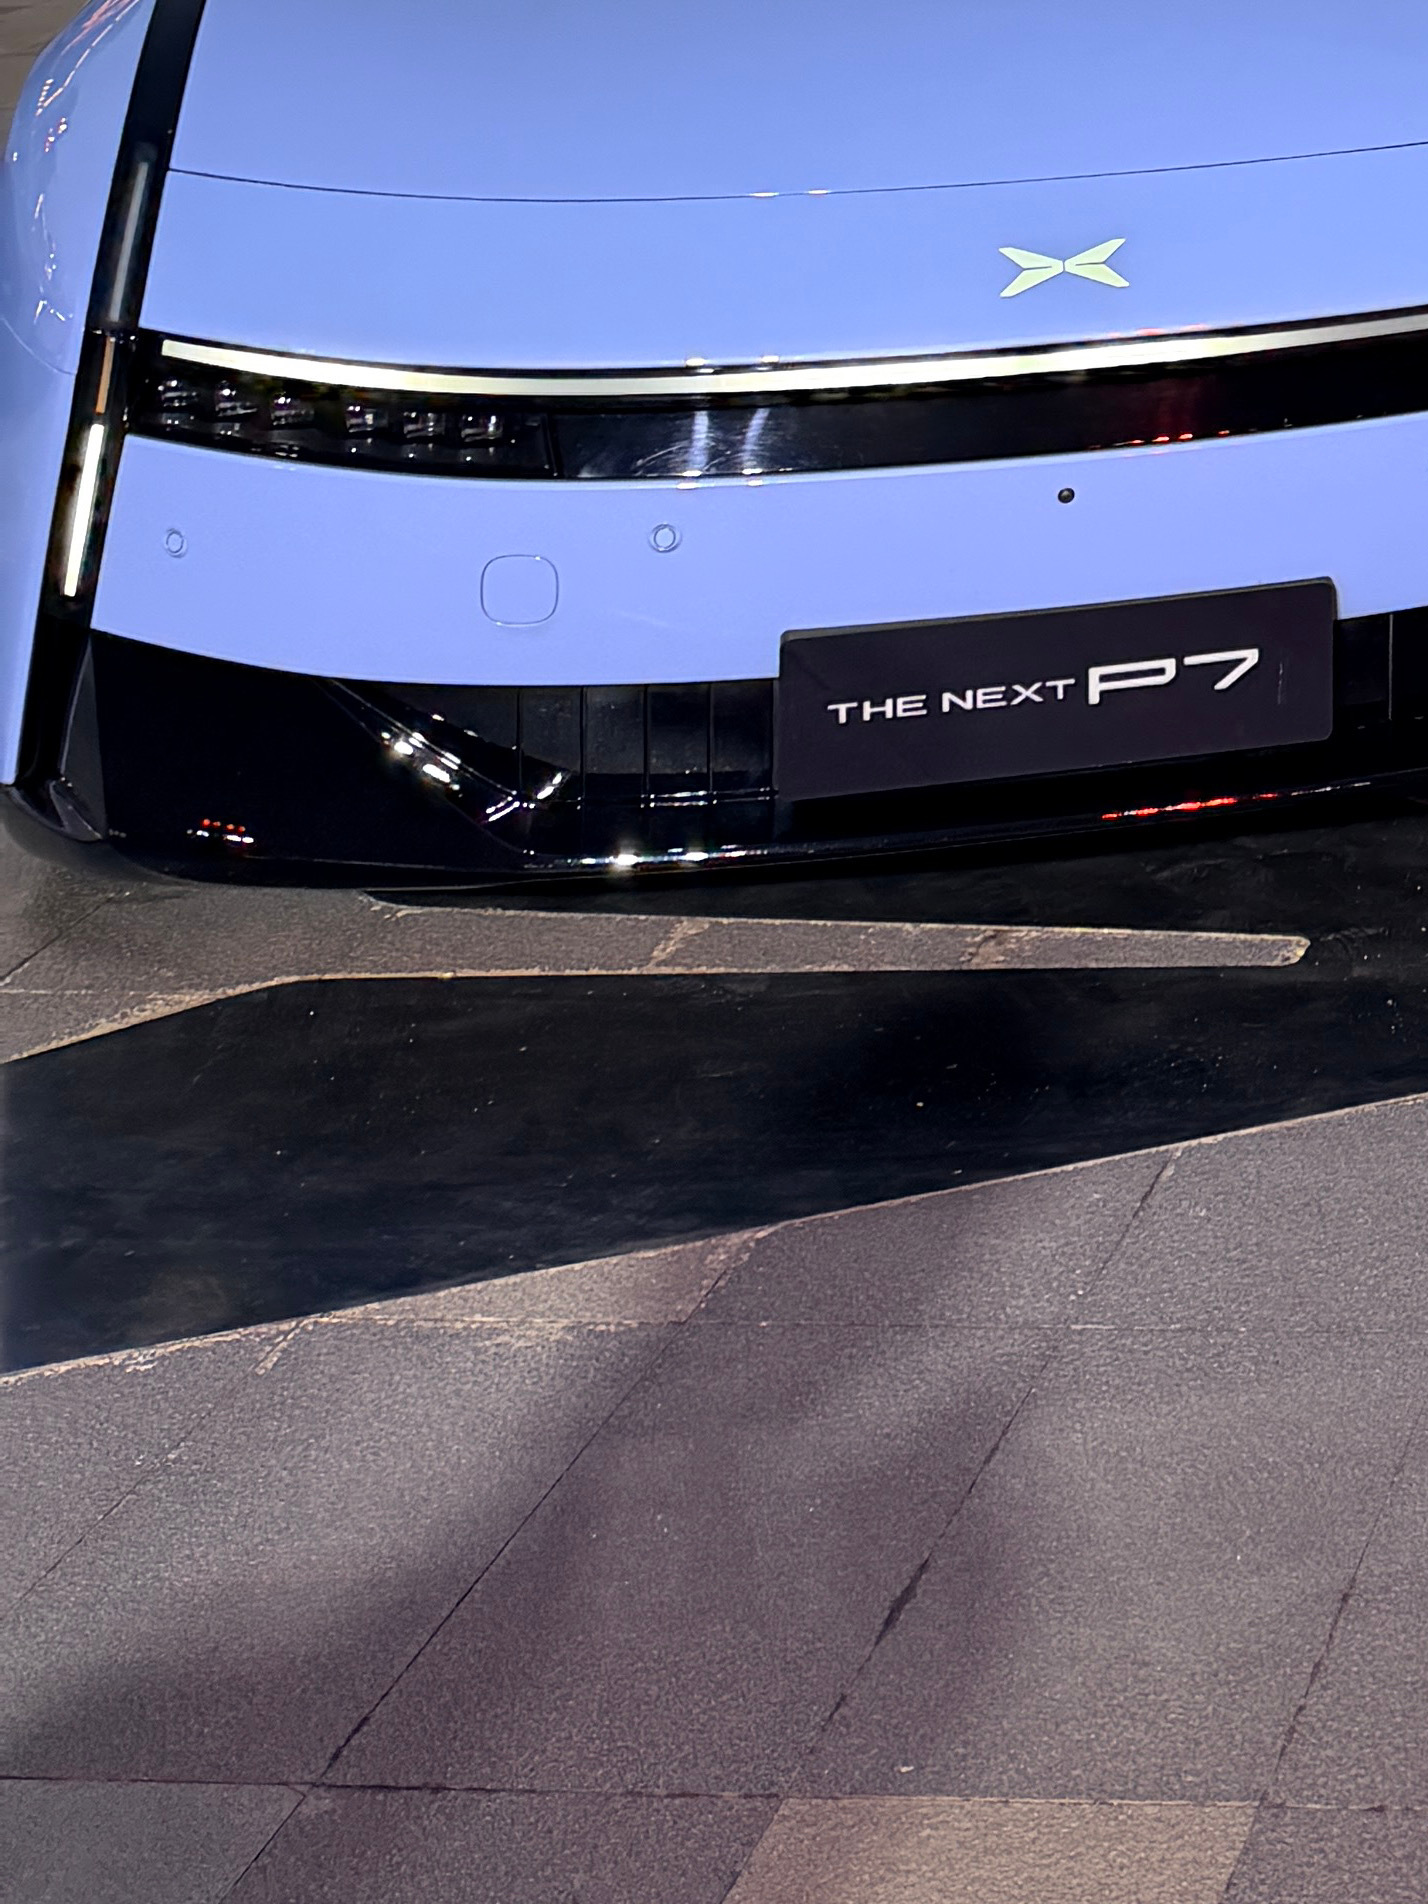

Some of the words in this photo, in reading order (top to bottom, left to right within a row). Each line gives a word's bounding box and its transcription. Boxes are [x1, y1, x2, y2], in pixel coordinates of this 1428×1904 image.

[827, 694, 929, 725] THE
[941, 678, 1076, 714] NEXT
[1088, 648, 1260, 706] P7
